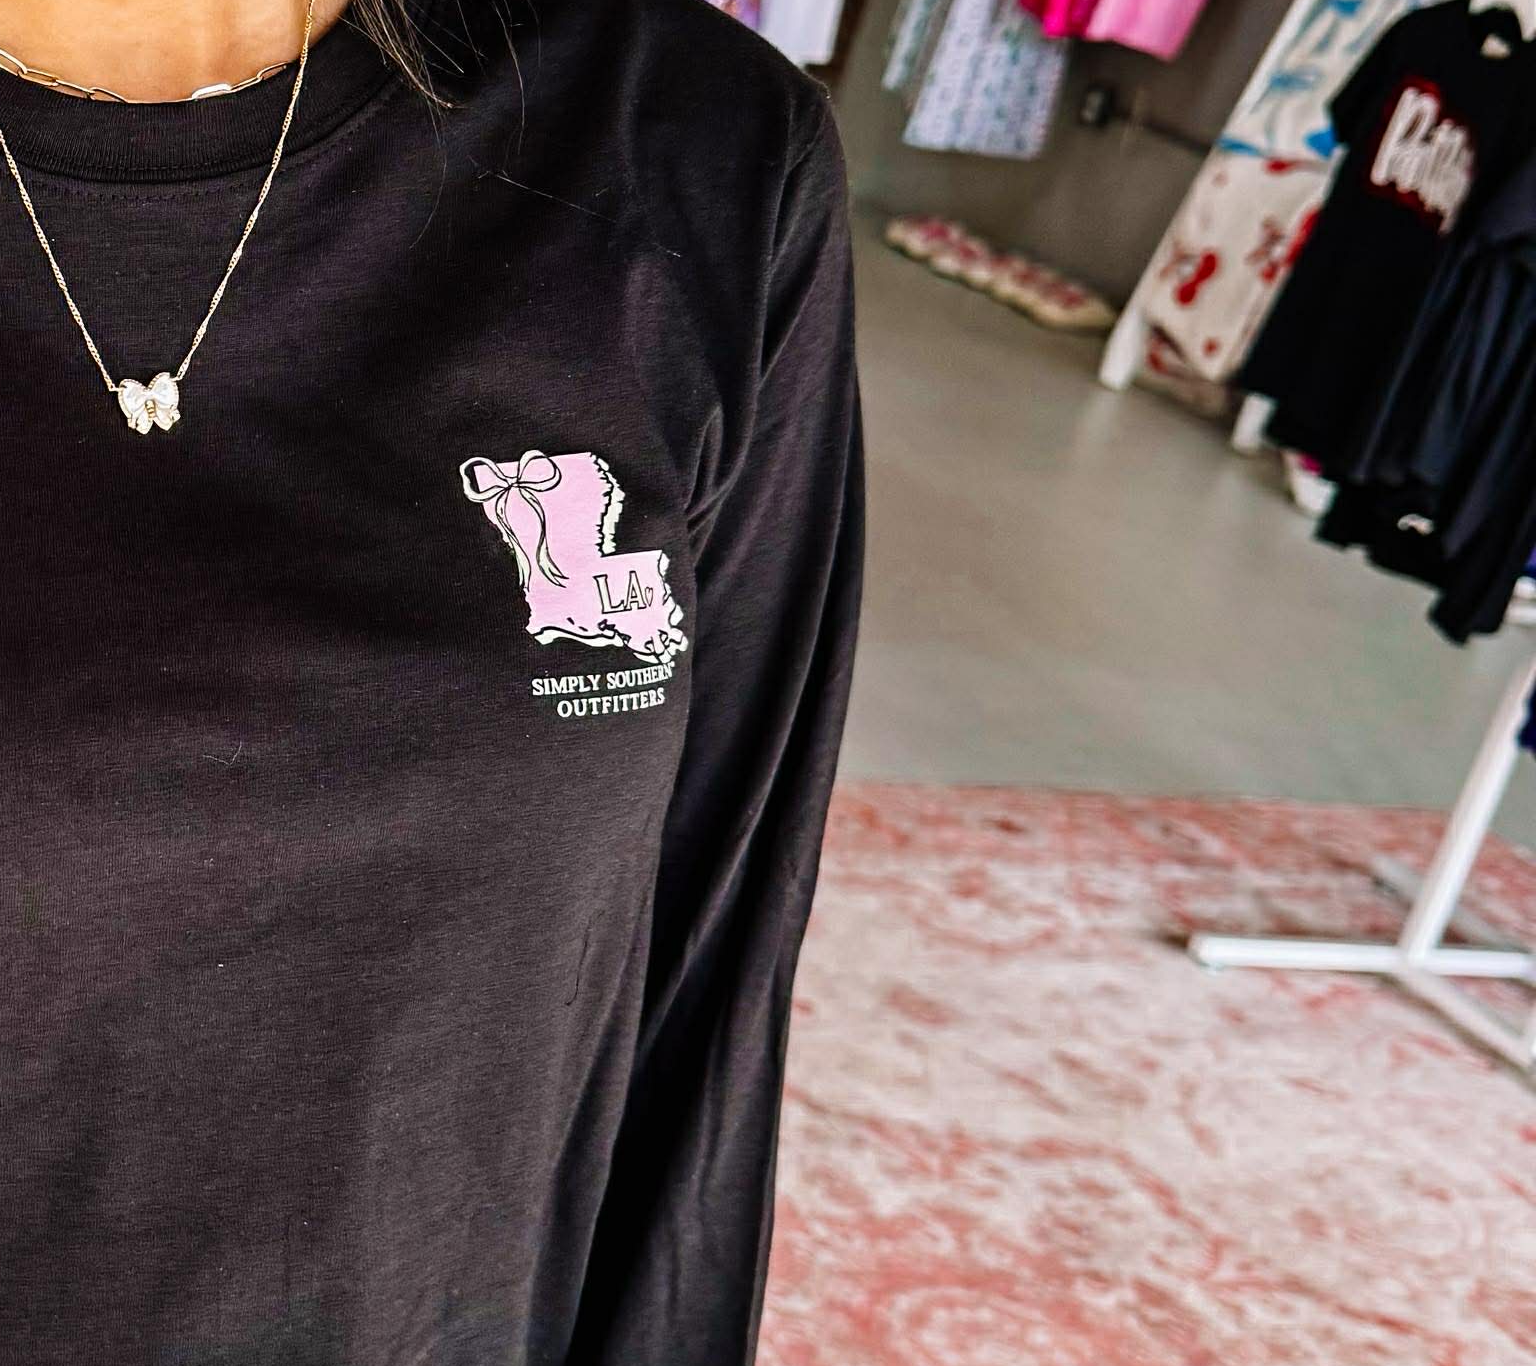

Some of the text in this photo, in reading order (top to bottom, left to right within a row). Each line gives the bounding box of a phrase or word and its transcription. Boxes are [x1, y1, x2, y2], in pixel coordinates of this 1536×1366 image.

[592, 570, 647, 614] LA
[531, 662, 673, 696] SIMPLY SOUTHERN
[557, 687, 665, 718] OUTFITTERS
